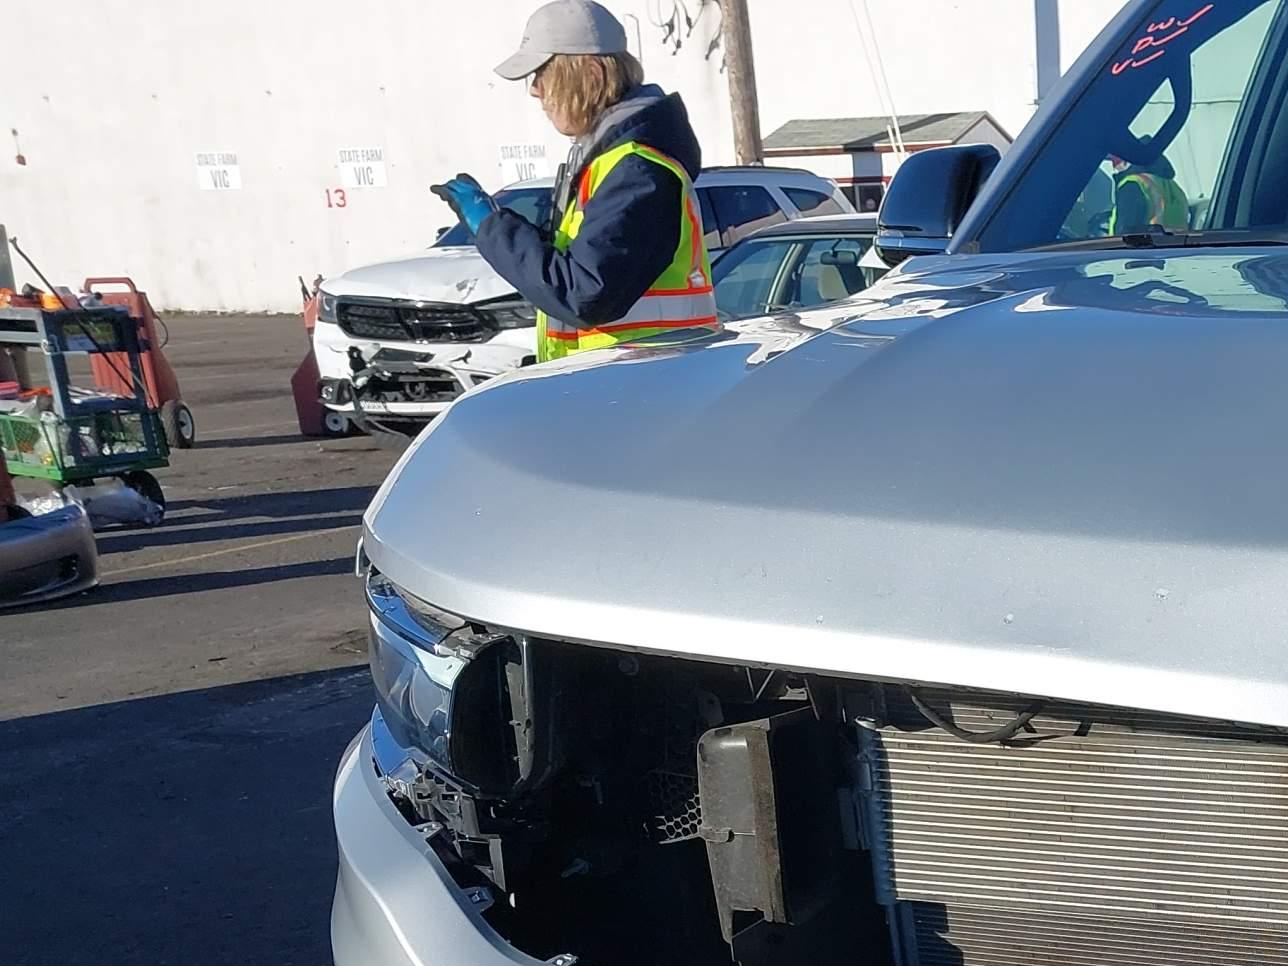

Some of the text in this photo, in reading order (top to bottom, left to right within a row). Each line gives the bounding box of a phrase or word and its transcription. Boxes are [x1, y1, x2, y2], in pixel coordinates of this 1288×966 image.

[197, 152, 237, 166] STATE FARM
[339, 148, 383, 164] STATE FARM
[501, 143, 546, 160] STATE FARM
[209, 169, 230, 189] VIC
[353, 166, 374, 186] VIC
[515, 163, 537, 182] VIC
[325, 188, 347, 209] 13
